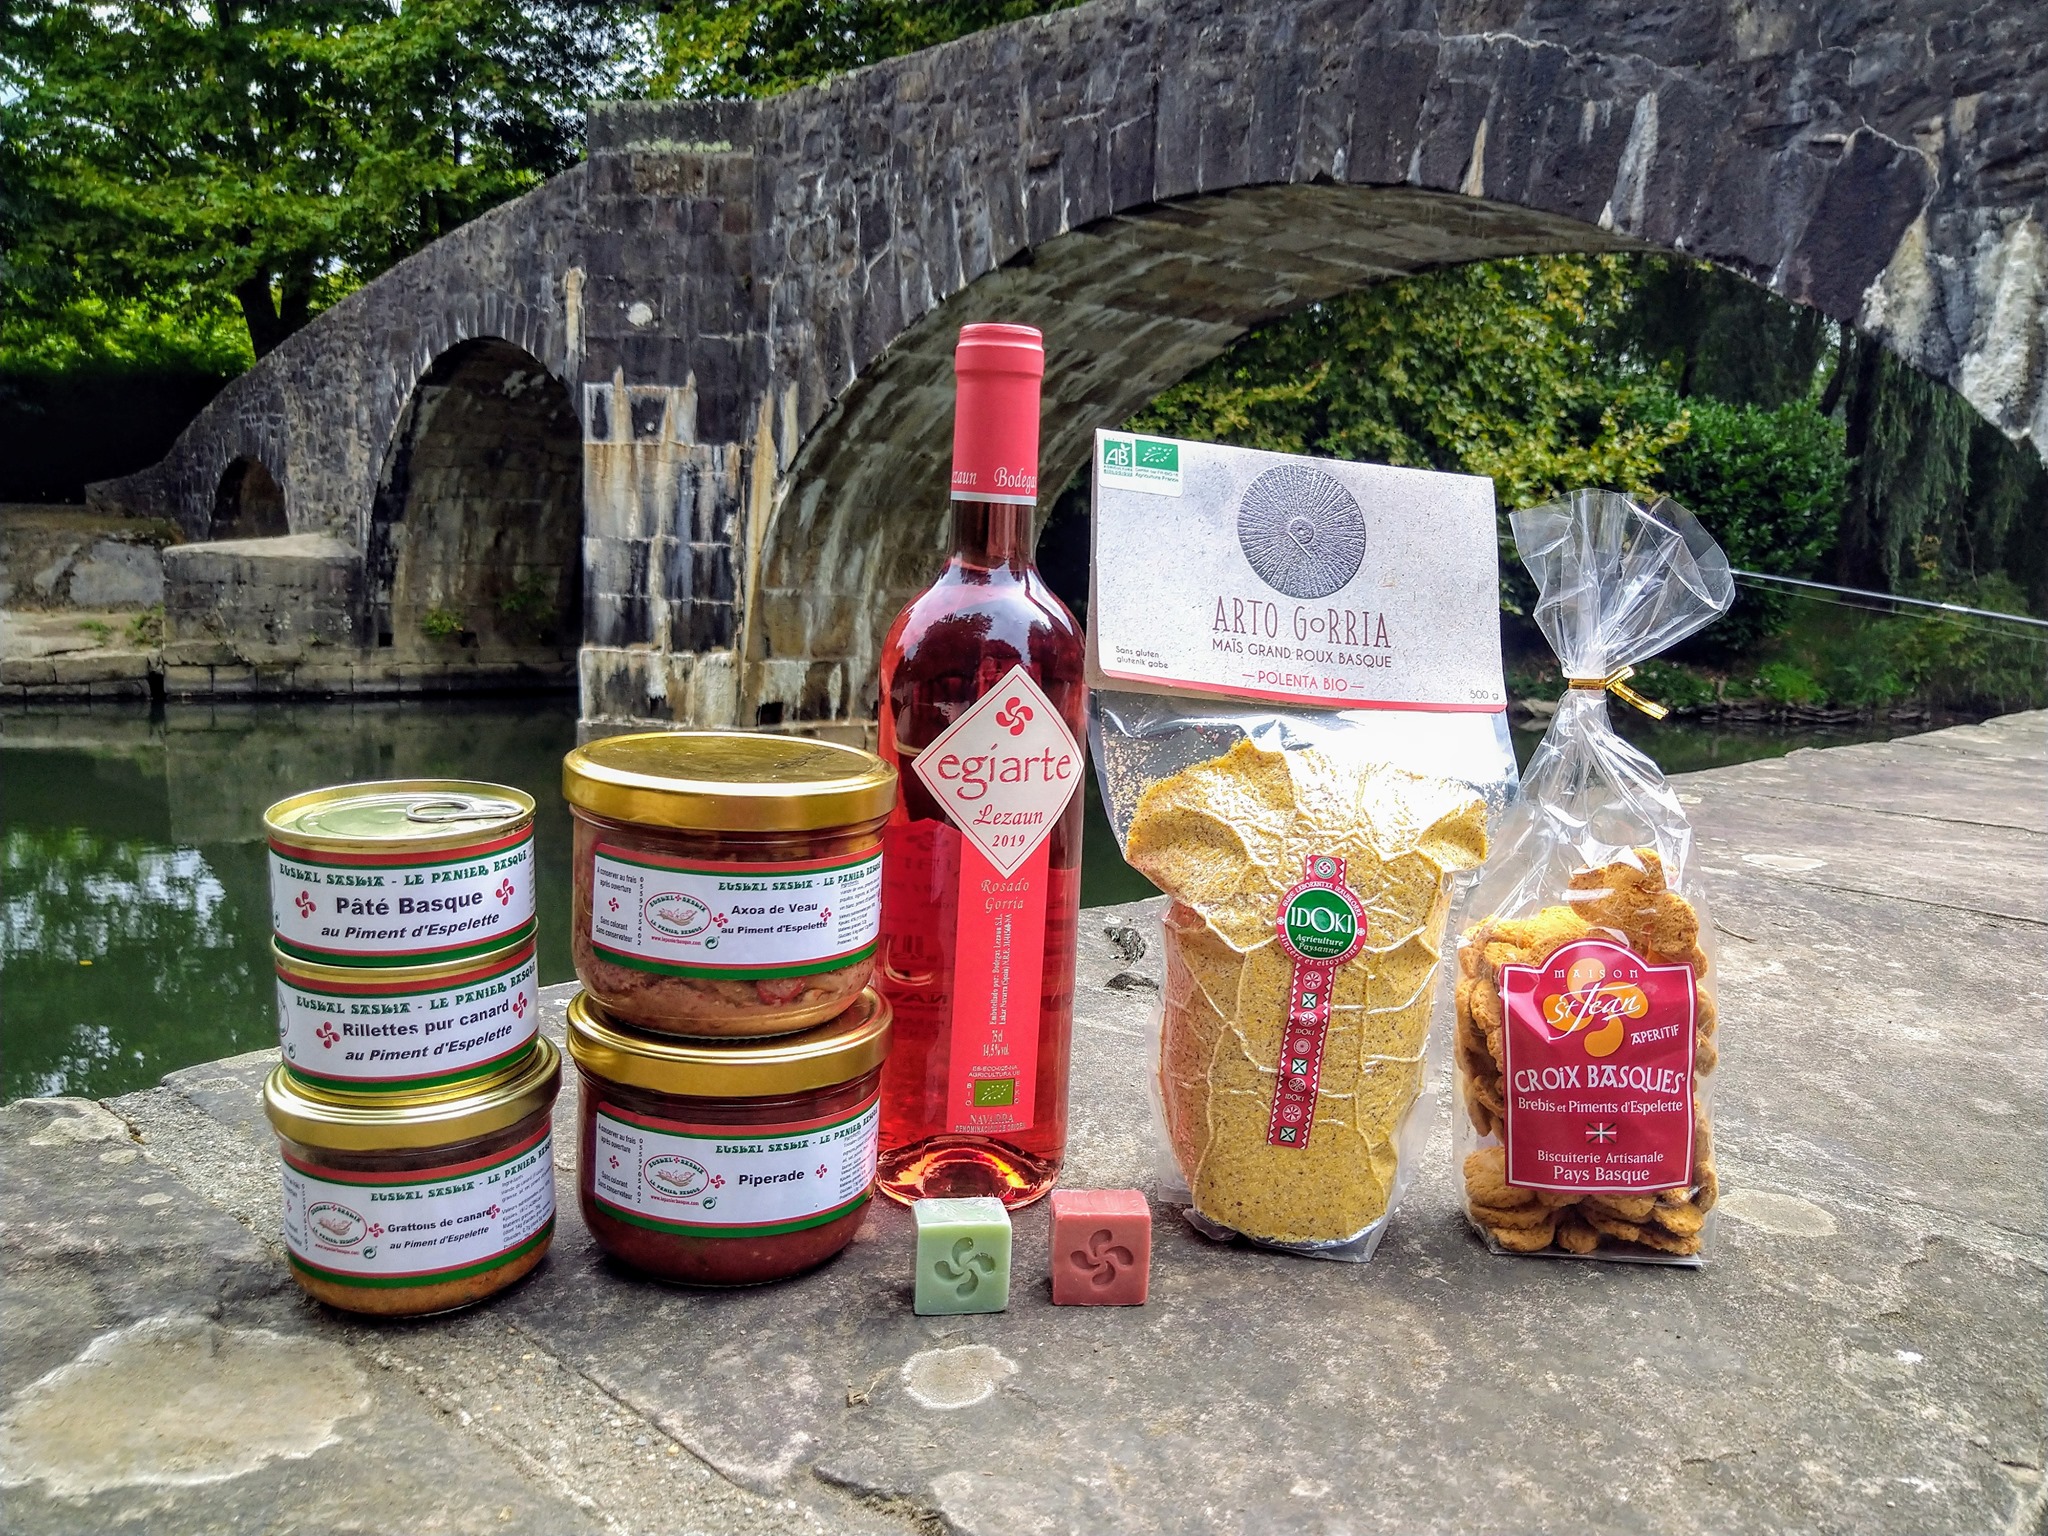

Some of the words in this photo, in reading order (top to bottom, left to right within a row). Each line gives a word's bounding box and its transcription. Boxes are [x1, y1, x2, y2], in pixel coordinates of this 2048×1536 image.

[1106, 448, 1129, 465] AB
[952, 470, 976, 485] zaun
[1212, 596, 1278, 638] ARTO
[1115, 645, 1132, 655] Sans
[1136, 648, 1160, 660] gluten
[1212, 638, 1243, 654] MAÏS
[1248, 643, 1290, 660] GRAND
[1296, 649, 1334, 665] ROUX
[1339, 653, 1392, 668] BASQUE
[1117, 655, 1145, 667] glutenik
[1148, 659, 1169, 670] gabe
[1258, 671, 1318, 689] POLENTA
[1323, 677, 1347, 692] BIO
[1470, 689, 1489, 699] 500
[937, 744, 1071, 800] egiarte
[973, 804, 1043, 826] Lezaun
[992, 835, 1026, 847] 2019
[280, 863, 321, 883] EUSKAL
[404, 874, 424, 885] LE
[493, 850, 527, 872] BASQUE
[600, 868, 619, 879] conserver
[626, 874, 637, 883] frais
[600, 879, 610, 887] après
[611, 883, 631, 894] ouverture
[824, 877, 834, 886] LE
[981, 878, 1029, 893] Rosado
[336, 896, 389, 915] Pâté
[399, 892, 483, 914] Basque
[731, 904, 767, 915] Axoa
[770, 904, 785, 914] de
[788, 902, 818, 912] Veau
[985, 896, 1024, 913] Gorria
[321, 927, 339, 937] au
[345, 926, 406, 939] Piment
[412, 913, 499, 937] d'Espelette
[600, 916, 609, 926] Sans
[610, 920, 628, 930] colorant
[721, 926, 734, 934] au
[737, 924, 774, 934] Piment
[777, 920, 827, 933] d'Espelette
[1290, 907, 1352, 933] IDOKI
[596, 925, 604, 933] Sans
[605, 929, 632, 942] conservateur
[1296, 934, 1343, 946] Agriculture
[1280, 934, 1302, 960] sincère
[1317, 944, 1358, 966] citoyenne
[1299, 941, 1339, 954] Paysanne
[992, 950, 1001, 973] Bodegas
[430, 999, 449, 1010] LE
[1000, 987, 1008, 1007] Navarra
[990, 989, 999, 1025] Embotellado
[1547, 993, 1577, 1023] St
[1548, 983, 1640, 1039] Jean
[343, 1023, 418, 1037] Rillettes
[425, 1020, 453, 1036] pur
[459, 1000, 509, 1026] canard
[1296, 1028, 1314, 1036] IDOKI
[346, 1050, 364, 1060] au
[370, 1048, 429, 1062] Piment
[433, 1024, 512, 1057] d'Espelette
[1285, 1093, 1304, 1102] IDOKI
[1518, 1097, 1555, 1112] Brebis
[1557, 1103, 1566, 1112] et
[1568, 1101, 1618, 1113] Piments
[1621, 1100, 1683, 1115] d'Espelette
[970, 1114, 1013, 1124] NAVARRA
[626, 1135, 636, 1144] frais
[820, 1134, 830, 1144] LE
[1538, 1150, 1600, 1163] Biscuiterie
[1605, 1151, 1663, 1163] Artisanale
[488, 1174, 500, 1184] LE
[611, 1177, 628, 1188] colorant
[739, 1169, 805, 1186] Piperade
[1554, 1166, 1589, 1181] Pays
[1595, 1167, 1650, 1184] Basque
[388, 1222, 436, 1232] Grattons
[439, 1218, 452, 1226] de
[456, 1208, 492, 1224] canard
[389, 1242, 402, 1250] au
[404, 1236, 437, 1249] Piment
[440, 1226, 489, 1246] d'Espelette
